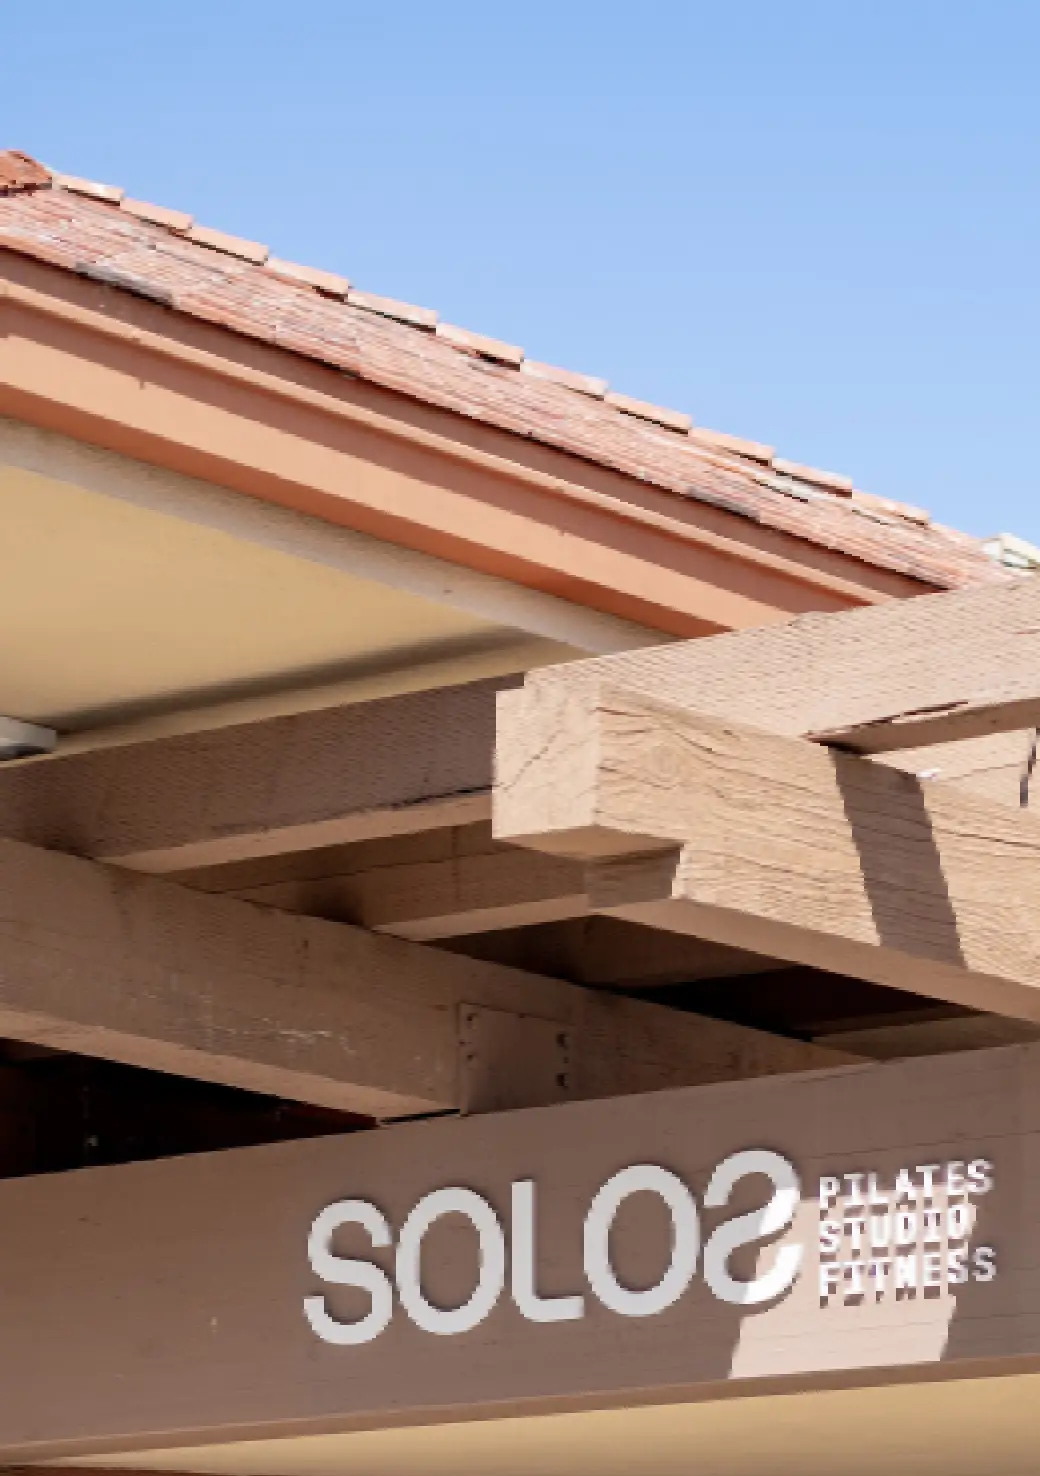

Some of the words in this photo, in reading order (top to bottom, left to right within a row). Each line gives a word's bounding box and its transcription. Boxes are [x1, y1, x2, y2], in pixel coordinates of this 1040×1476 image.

[819, 1158, 995, 1209] PILATES
[303, 1147, 801, 1345] SOLOS
[819, 1204, 970, 1253] STUDIO
[819, 1247, 997, 1297] FITNESS
